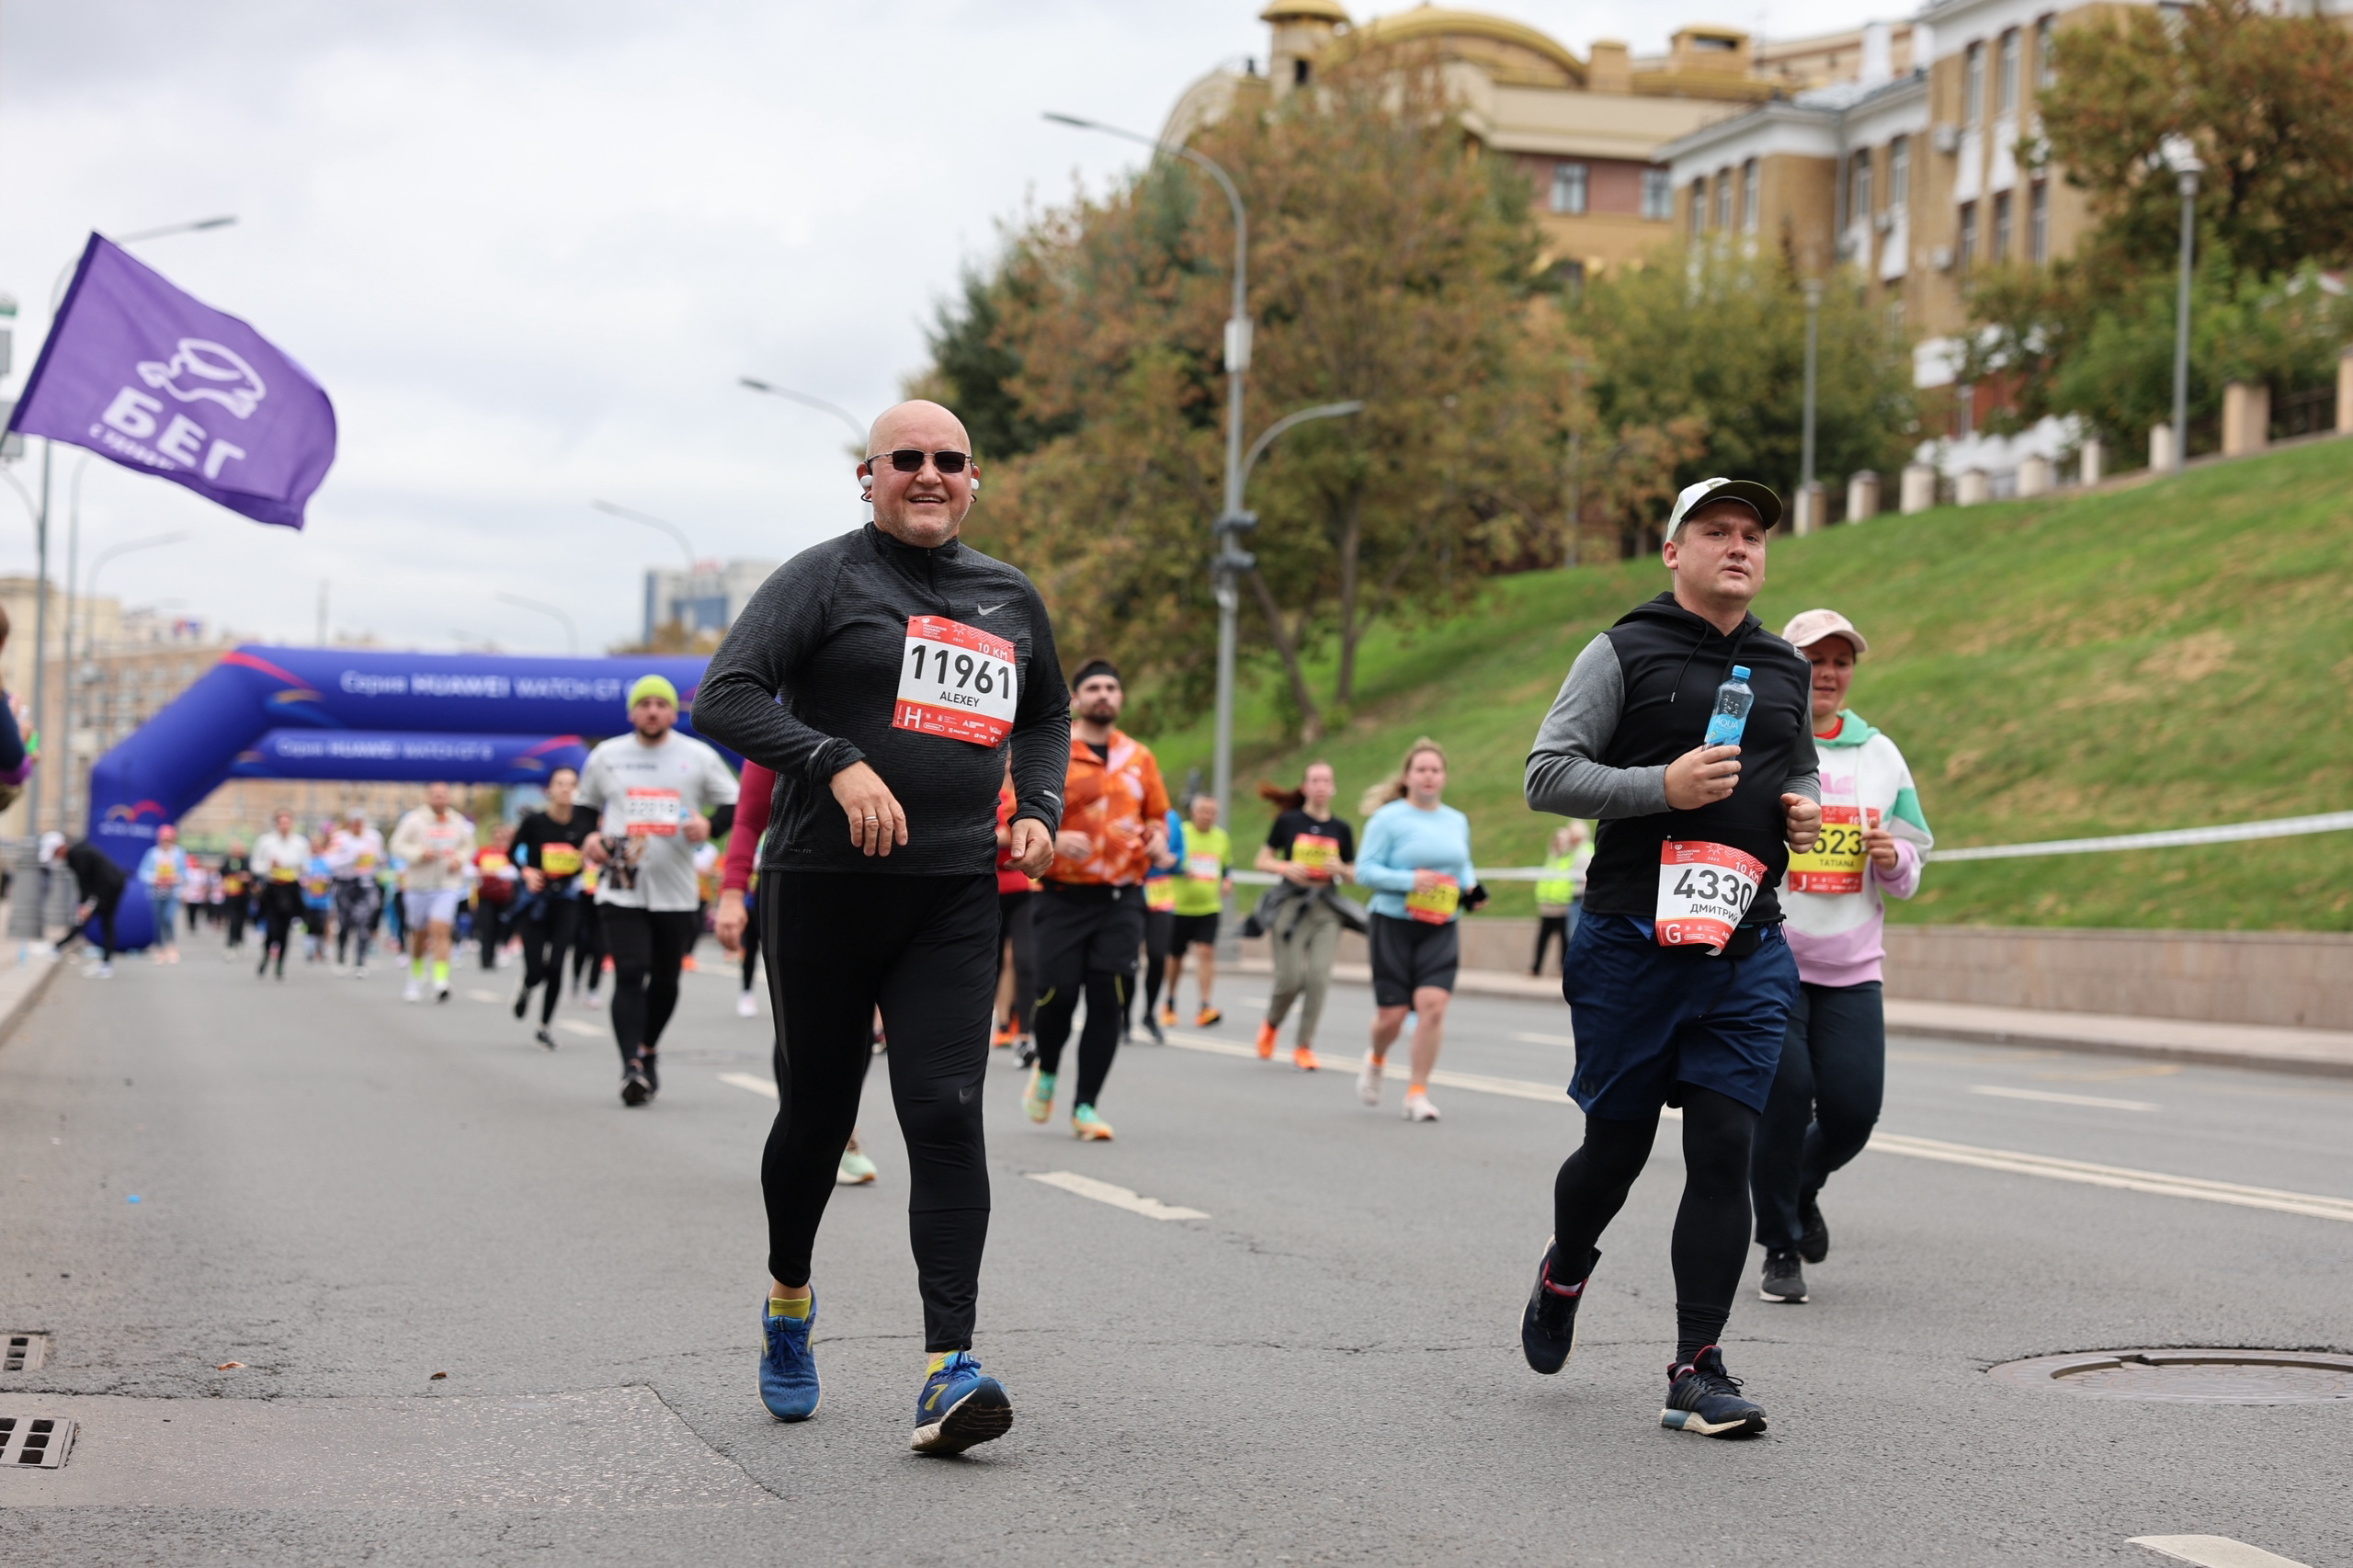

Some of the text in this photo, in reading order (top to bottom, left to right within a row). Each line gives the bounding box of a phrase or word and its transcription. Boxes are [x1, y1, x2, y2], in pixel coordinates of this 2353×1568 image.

[101, 386, 246, 480] БЕГ
[977, 642, 1008, 661] 10 KM
[911, 644, 1010, 699] 11961
[340, 669, 408, 699] Серия
[410, 672, 511, 699] HUAWEI
[513, 675, 592, 701] WATCH
[592, 677, 623, 702] GT
[939, 691, 980, 708] ALEXEY
[904, 706, 922, 729] H
[1715, 716, 1739, 730] AQUA
[1735, 861, 1747, 874] 10
[1819, 858, 1855, 868] TATIANA
[1674, 869, 1753, 915] 4330
[1798, 874, 1807, 892] J
[1689, 903, 1739, 924] ДМИТРИЙ
[1665, 923, 1682, 944] G
